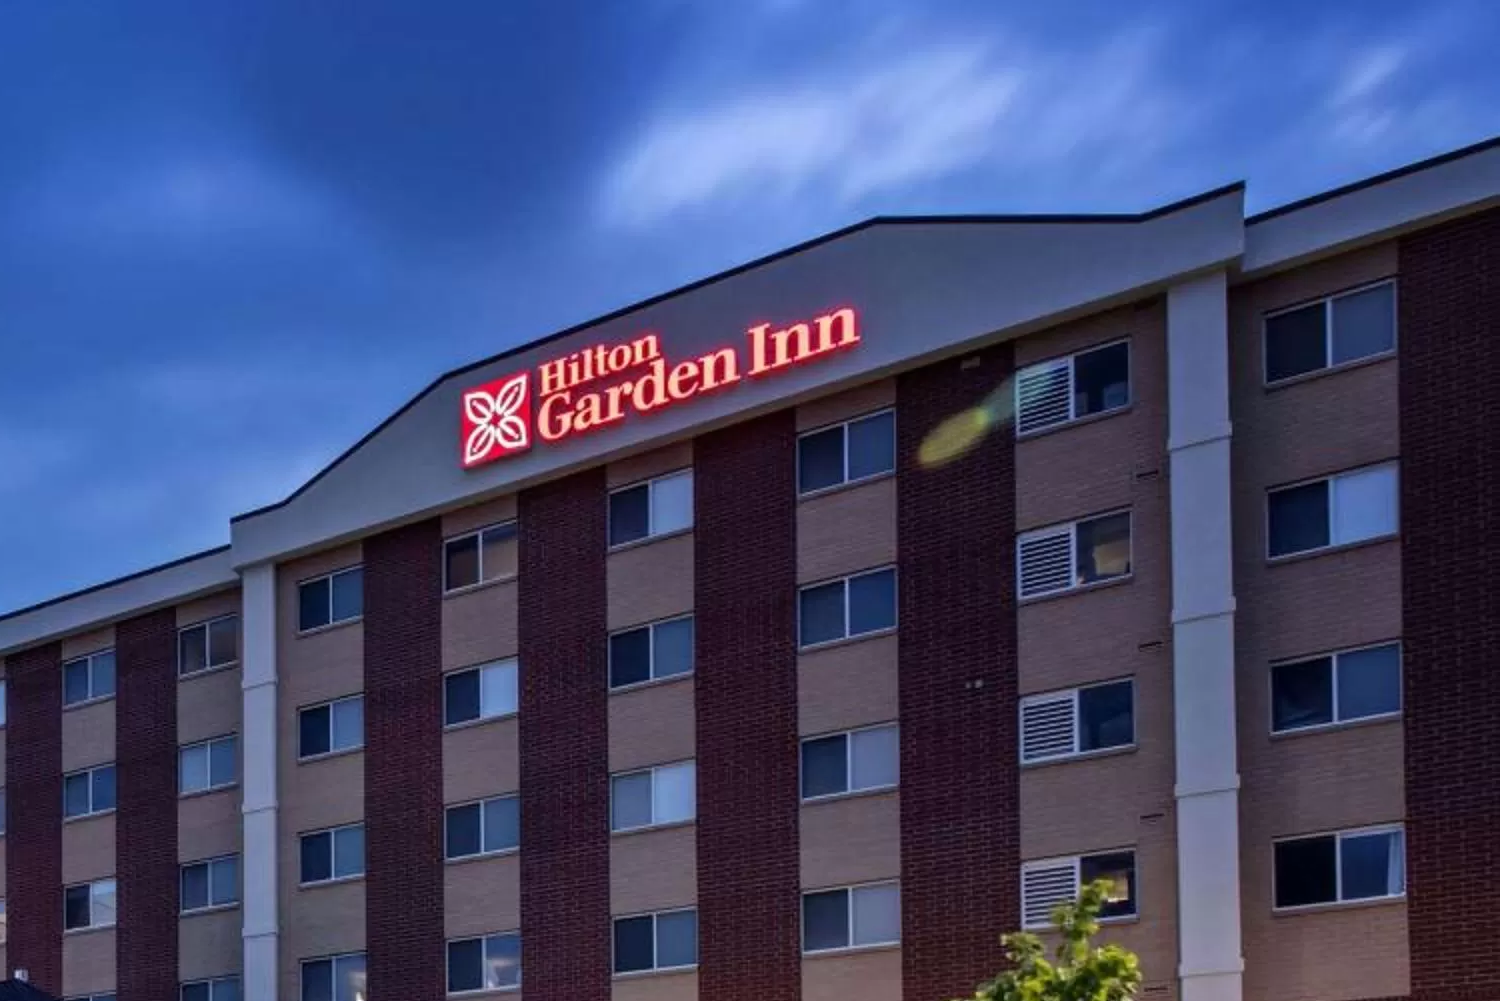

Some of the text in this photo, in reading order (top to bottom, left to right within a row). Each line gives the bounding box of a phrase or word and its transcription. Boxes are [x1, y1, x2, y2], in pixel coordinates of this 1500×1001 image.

[536, 306, 861, 442] Garden Inn
[538, 334, 661, 398] Hilton
